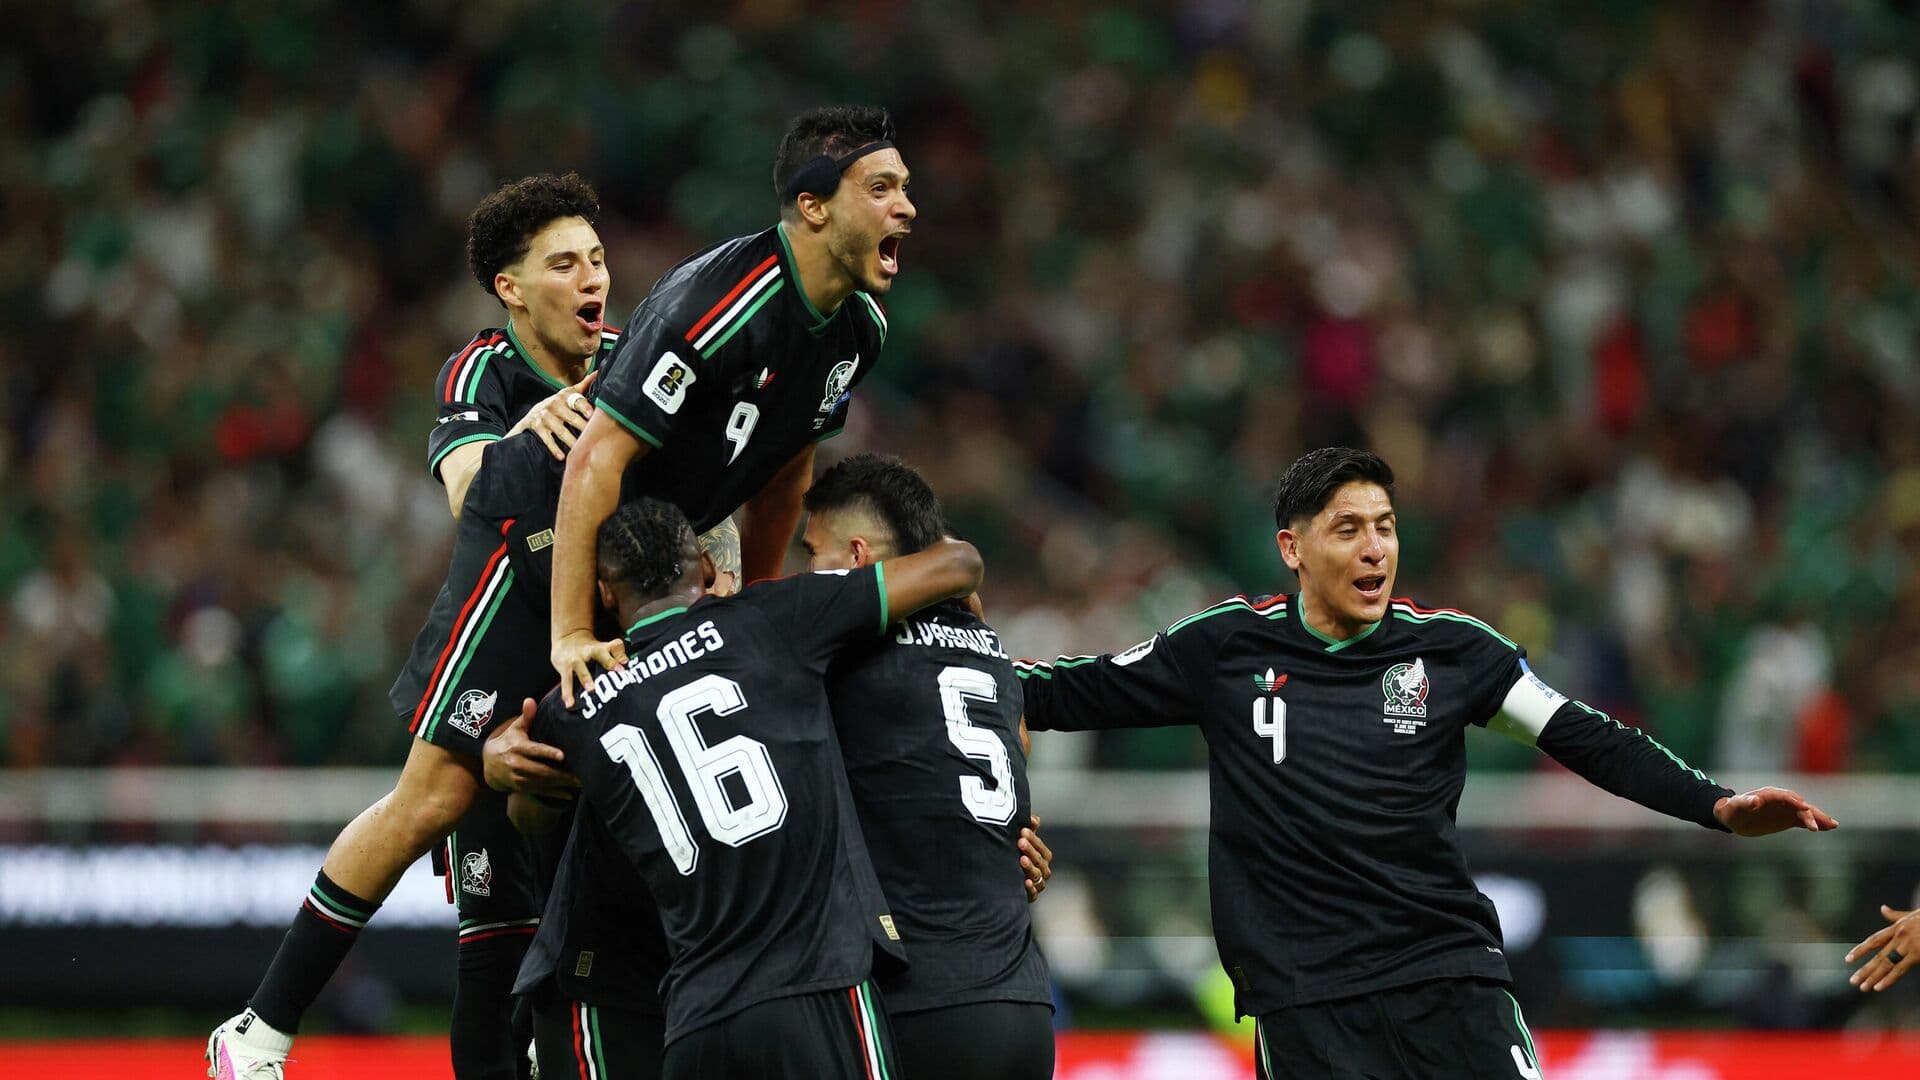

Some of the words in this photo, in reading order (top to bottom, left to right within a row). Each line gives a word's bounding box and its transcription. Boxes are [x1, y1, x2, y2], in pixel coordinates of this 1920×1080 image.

[725, 401, 760, 467] 9
[1253, 697, 1287, 765] 4
[1386, 703, 1425, 715] MÉXICO
[600, 674, 788, 876] 16
[937, 666, 1017, 826] 5
